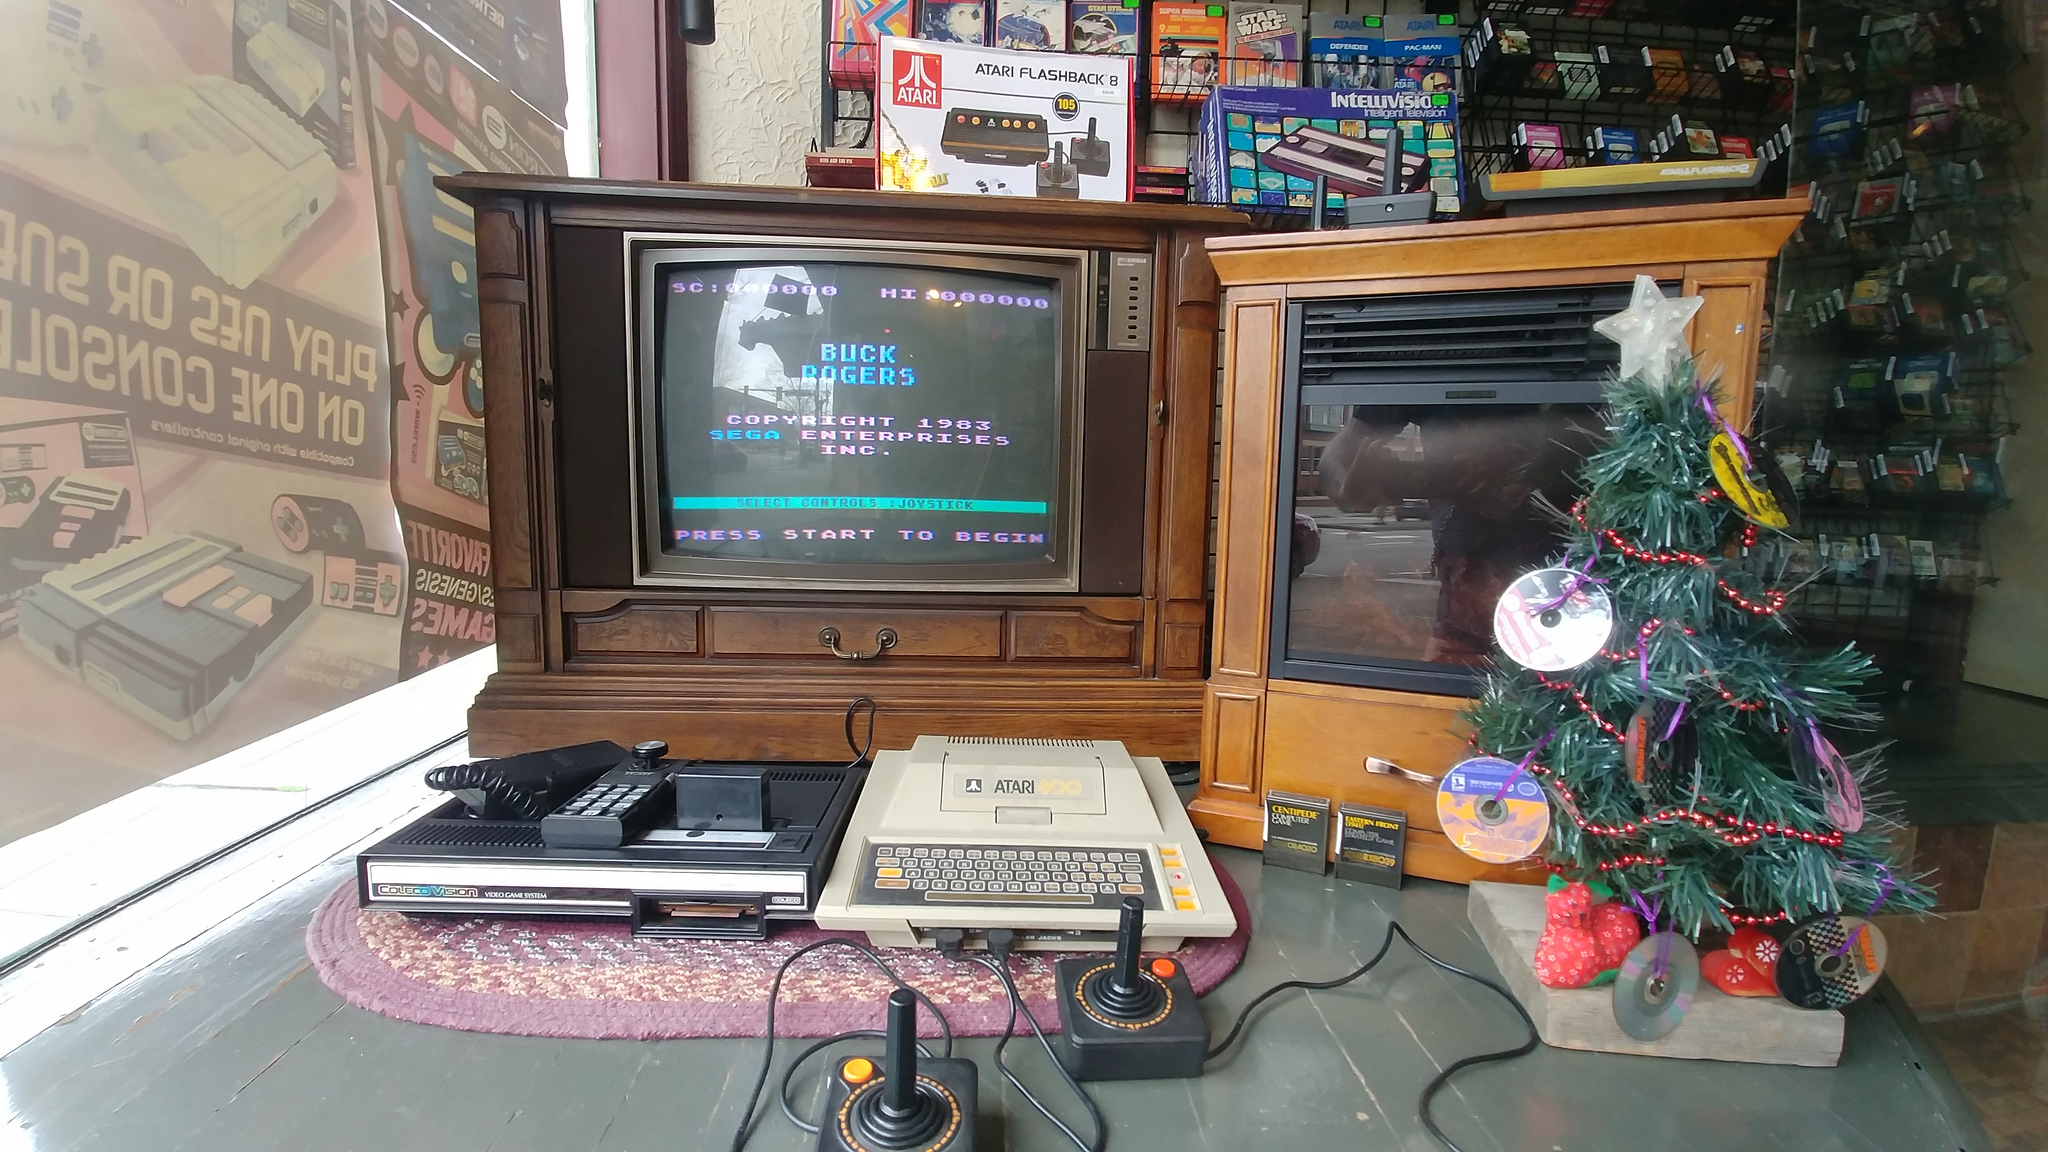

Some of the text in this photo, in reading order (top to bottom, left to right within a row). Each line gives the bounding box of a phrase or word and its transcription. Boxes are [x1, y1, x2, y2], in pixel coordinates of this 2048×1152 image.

[1236, 10, 1286, 26] STAR
[1237, 17, 1287, 35] WARS
[1330, 43, 1369, 51] DEFENDER
[975, 63, 1119, 86] ATARI FLASHBACK 8
[1394, 81, 1415, 89] ATARI
[897, 86, 937, 105] ATARI
[1057, 98, 1076, 110] 105
[1364, 108, 1447, 119] Intelligent Television
[671, 282, 838, 297] SC:000000
[820, 342, 897, 365] BUCK
[801, 365, 916, 386] ROGERS
[726, 414, 992, 431] COPYRIGHT 1983
[709, 429, 1011, 447] SEGA ENTERPRISES
[820, 444, 892, 457] INC.
[736, 497, 791, 509] SELECT
[801, 498, 878, 509] CONTROLS
[674, 528, 1045, 545] PRESS START TO BEGIN
[994, 779, 1083, 795] ATARI 400
[1271, 812, 1310, 825] COMPUTER
[1272, 805, 1319, 820] CENTIPEDE
[1271, 818, 1292, 827] GAME
[1345, 815, 1399, 831] EASTERN FRONT
[1375, 837, 1395, 846] GAME
